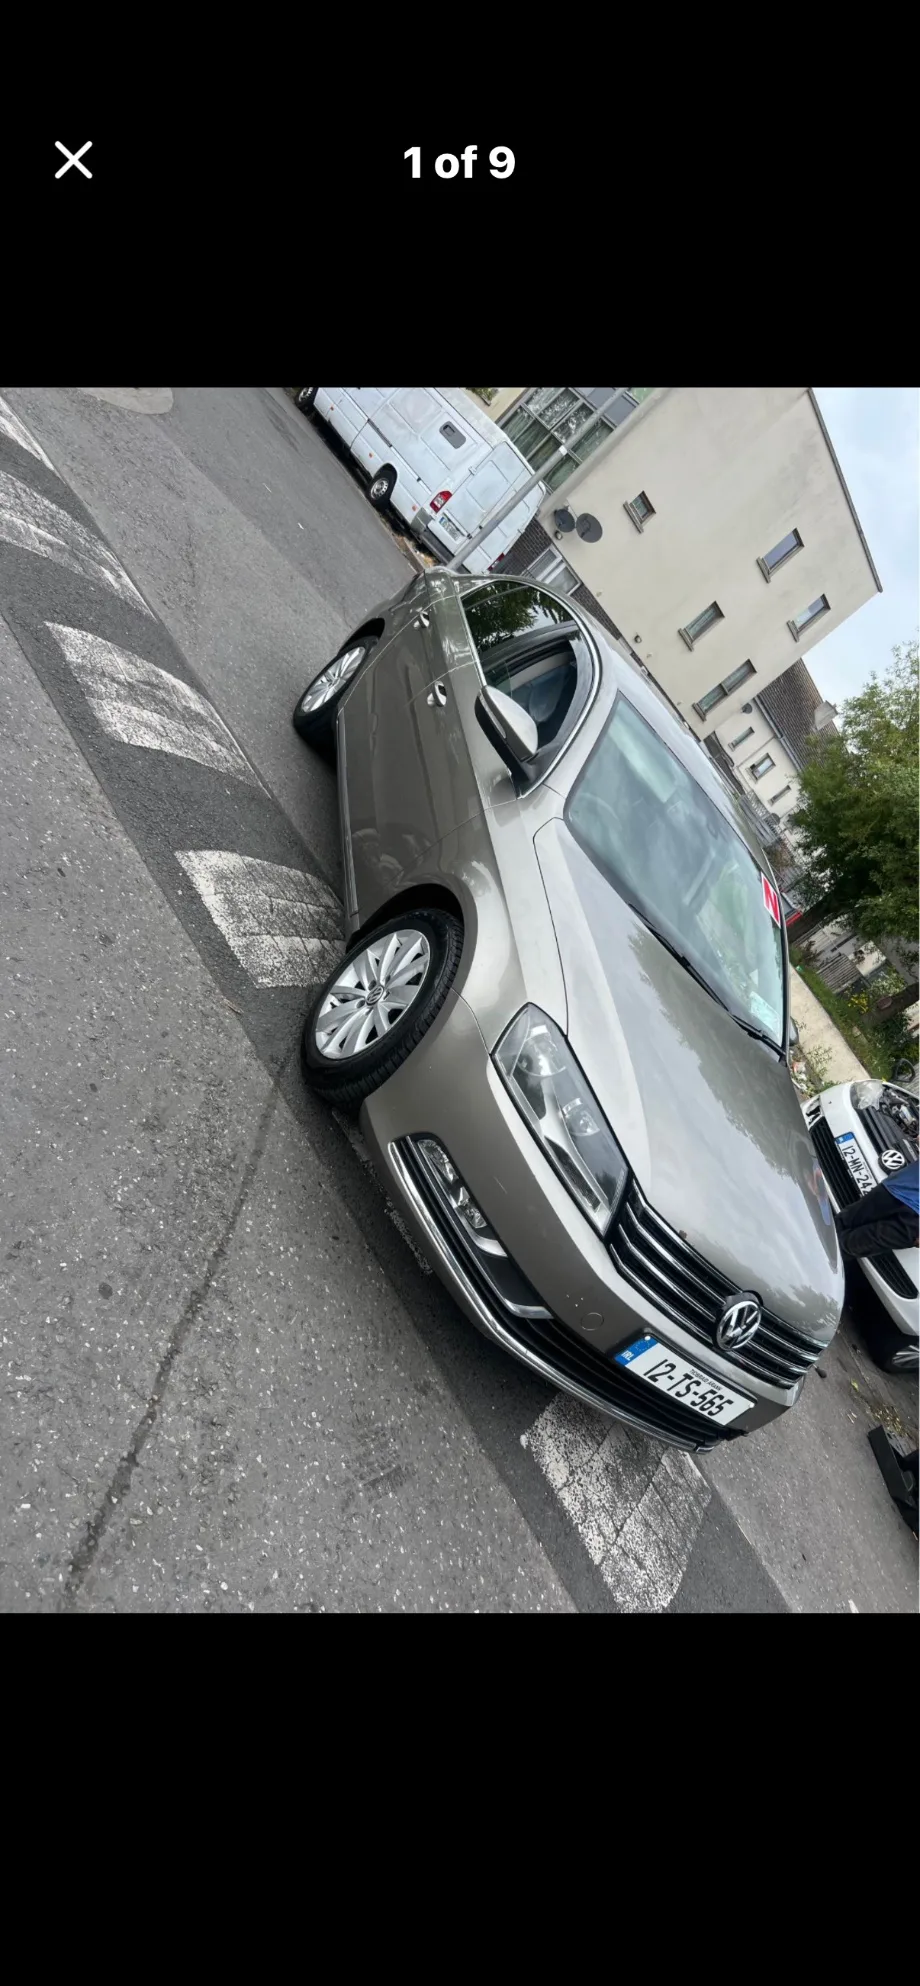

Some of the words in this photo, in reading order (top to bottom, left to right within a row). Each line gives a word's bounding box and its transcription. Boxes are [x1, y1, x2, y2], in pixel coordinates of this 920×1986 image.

[763, 876, 780, 924] N
[881, 1149, 905, 1170] VW
[717, 1300, 761, 1350] VW
[643, 1358, 734, 1417] 12-TS-565
